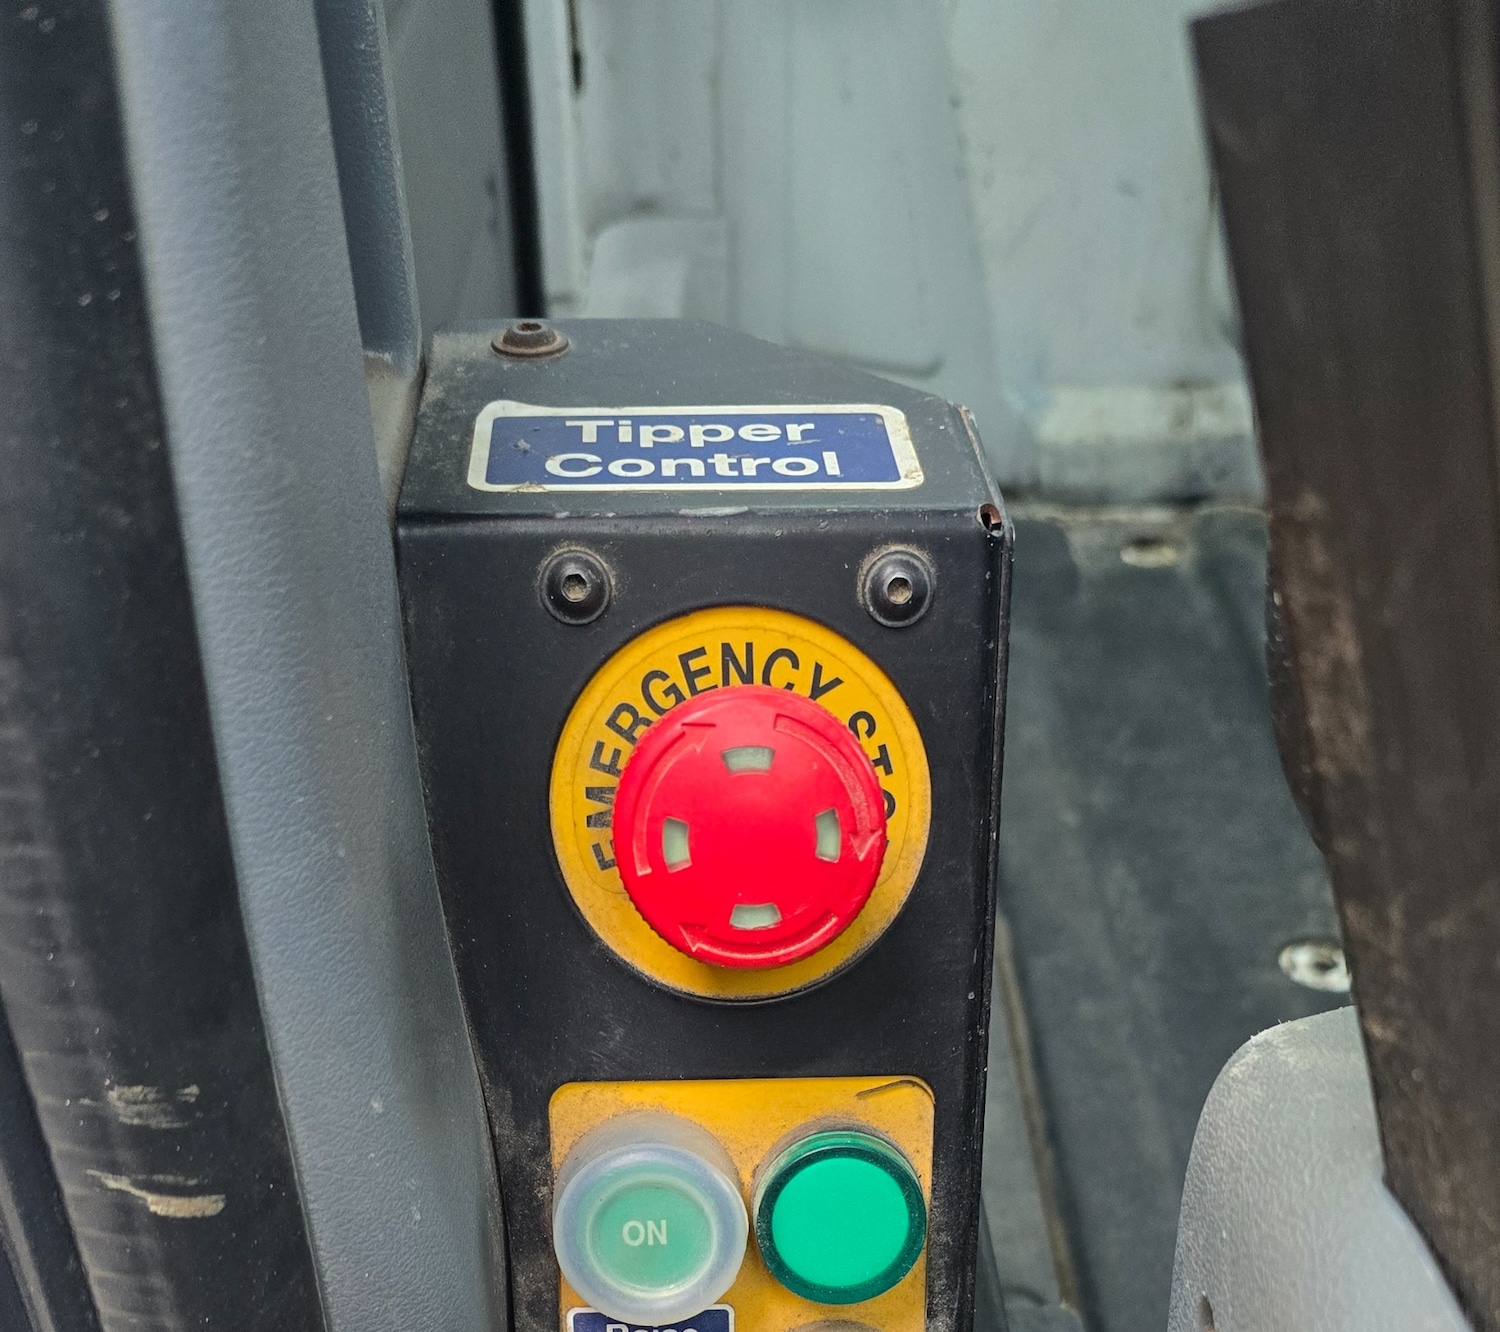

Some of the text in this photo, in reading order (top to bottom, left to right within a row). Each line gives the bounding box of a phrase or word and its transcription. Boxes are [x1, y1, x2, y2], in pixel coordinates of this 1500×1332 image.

[565, 420, 815, 448] Tipper
[545, 451, 841, 477] Control
[622, 1219, 668, 1247] ON
